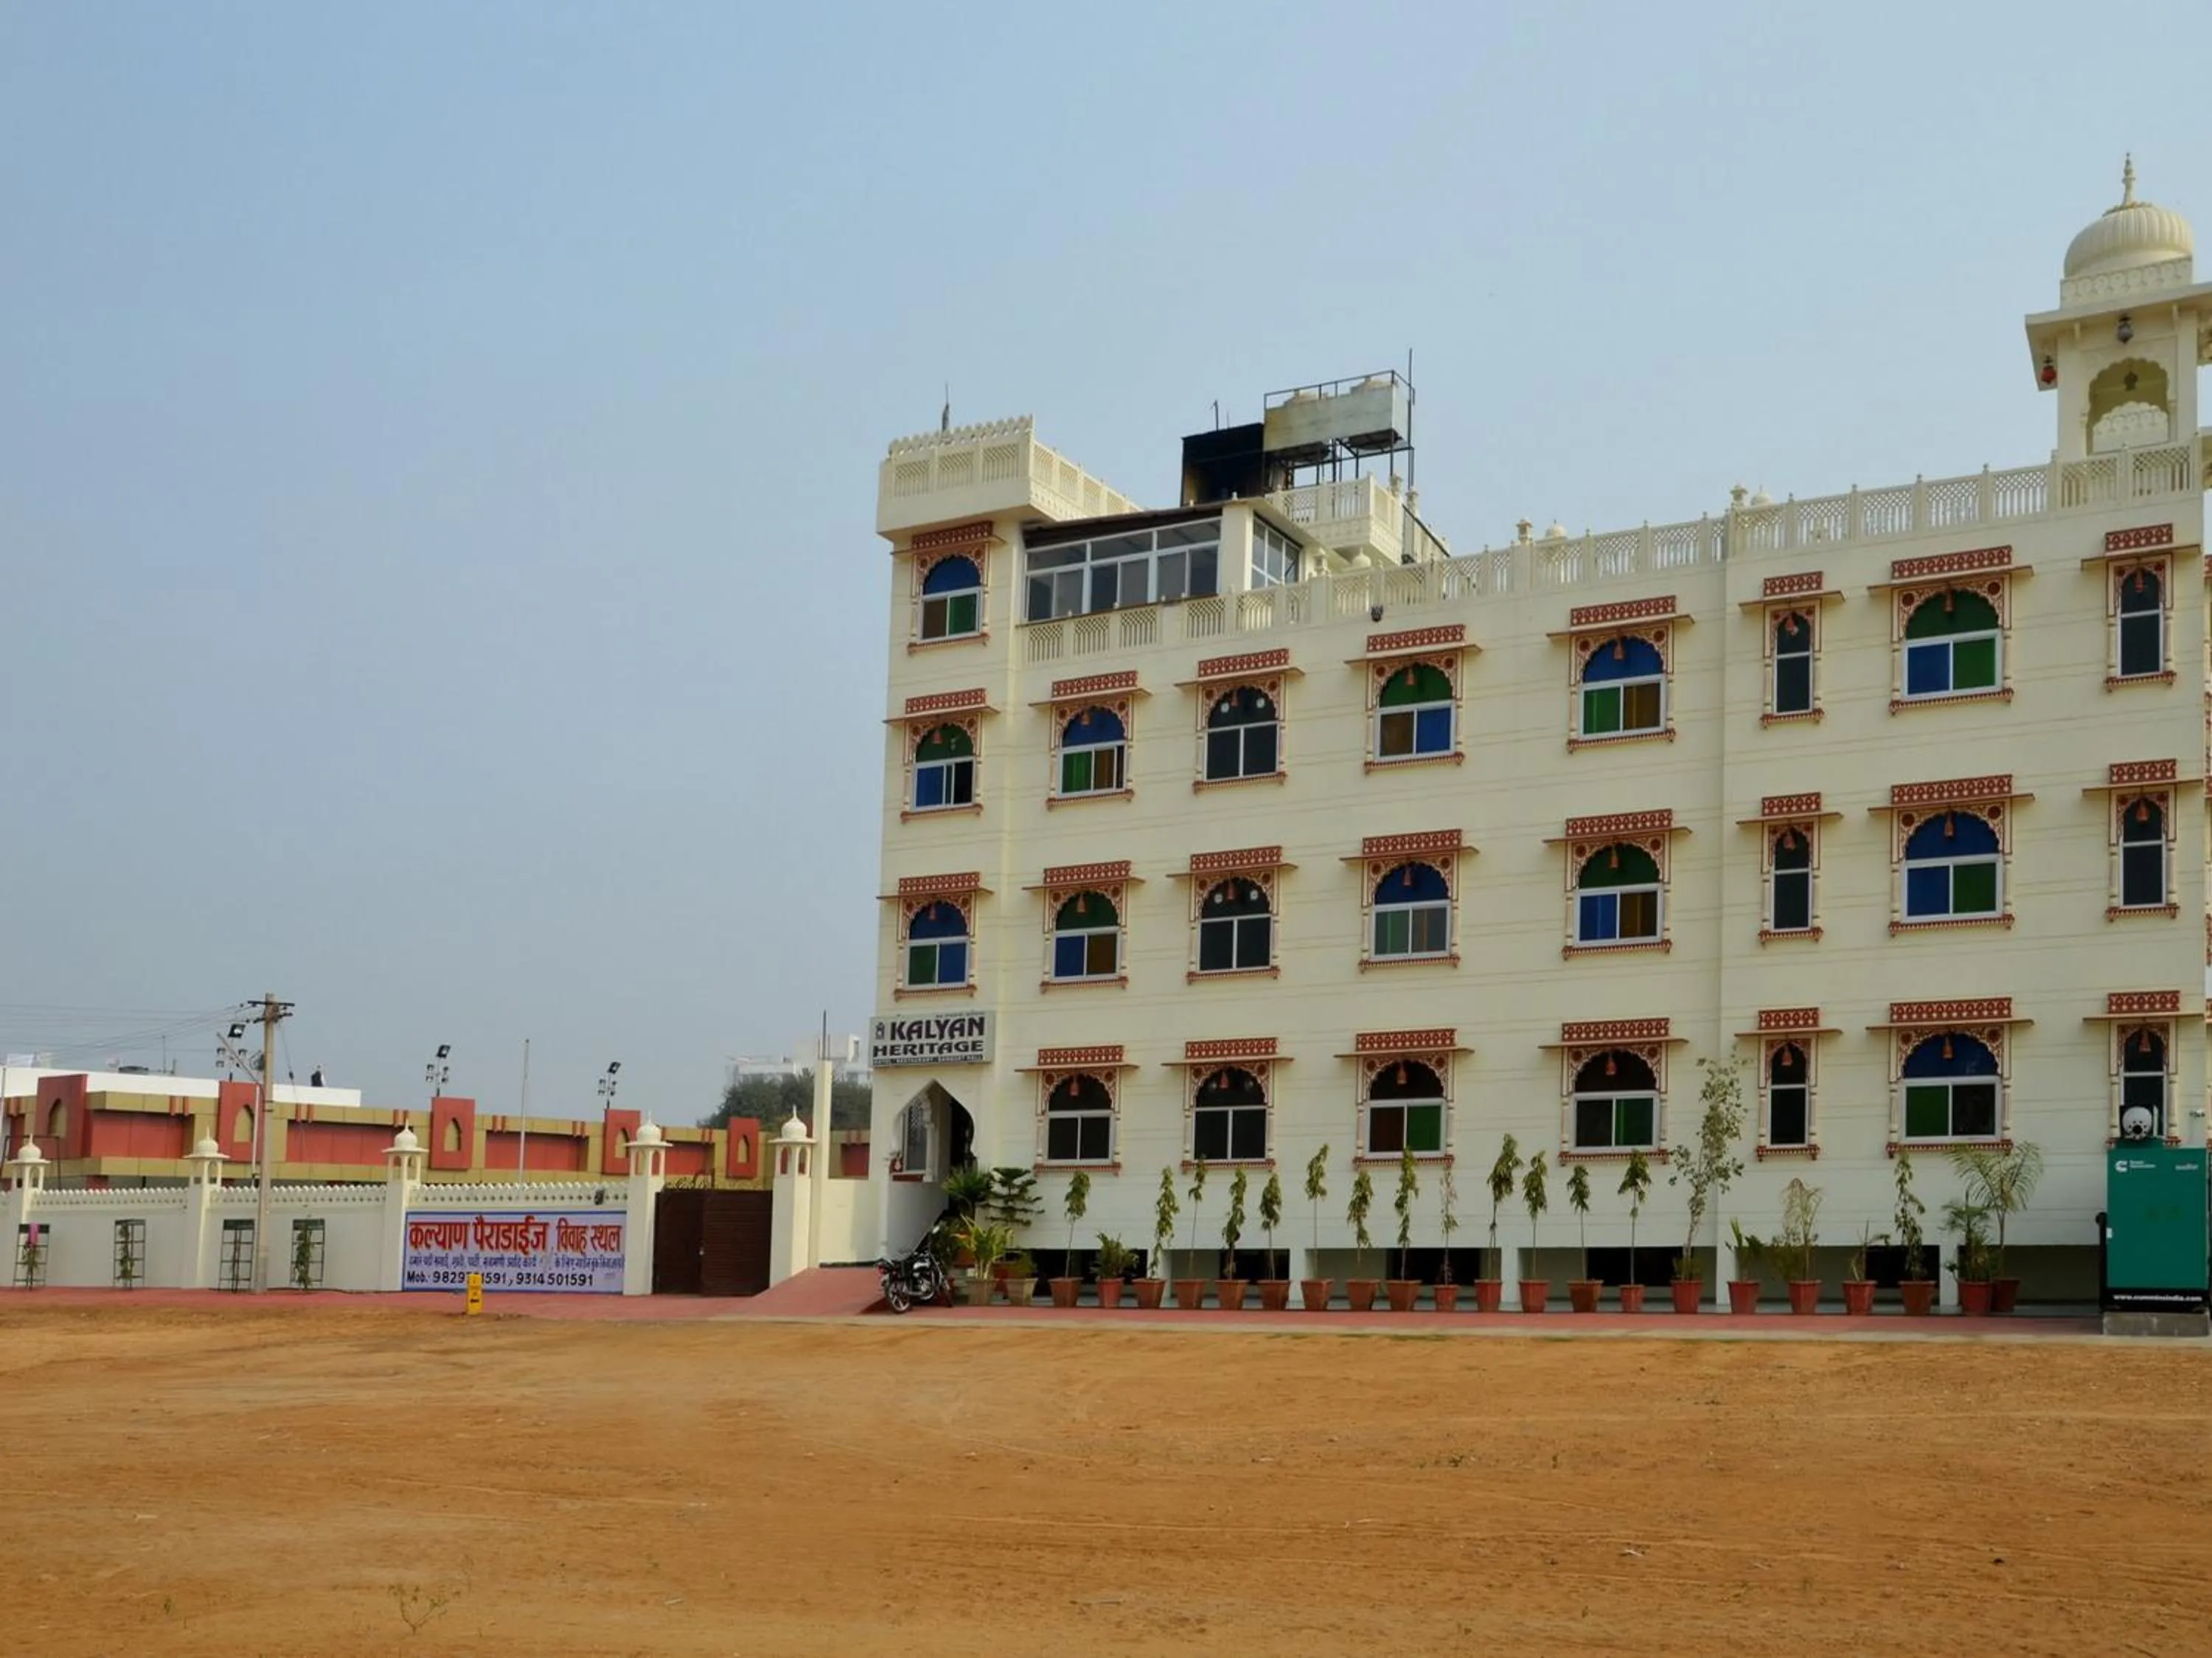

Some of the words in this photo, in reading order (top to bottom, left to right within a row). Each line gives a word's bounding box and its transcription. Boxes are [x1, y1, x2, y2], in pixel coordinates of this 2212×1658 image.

[890, 1017, 985, 1042] KALYAN
[873, 1041, 984, 1058] HERITAGE
[409, 1221, 470, 1251] कल्याण
[473, 1215, 549, 1255] पैराडाईज
[557, 1218, 588, 1257] विवाह
[590, 1224, 622, 1252] स्थल
[433, 1271, 512, 1286] 98291591,
